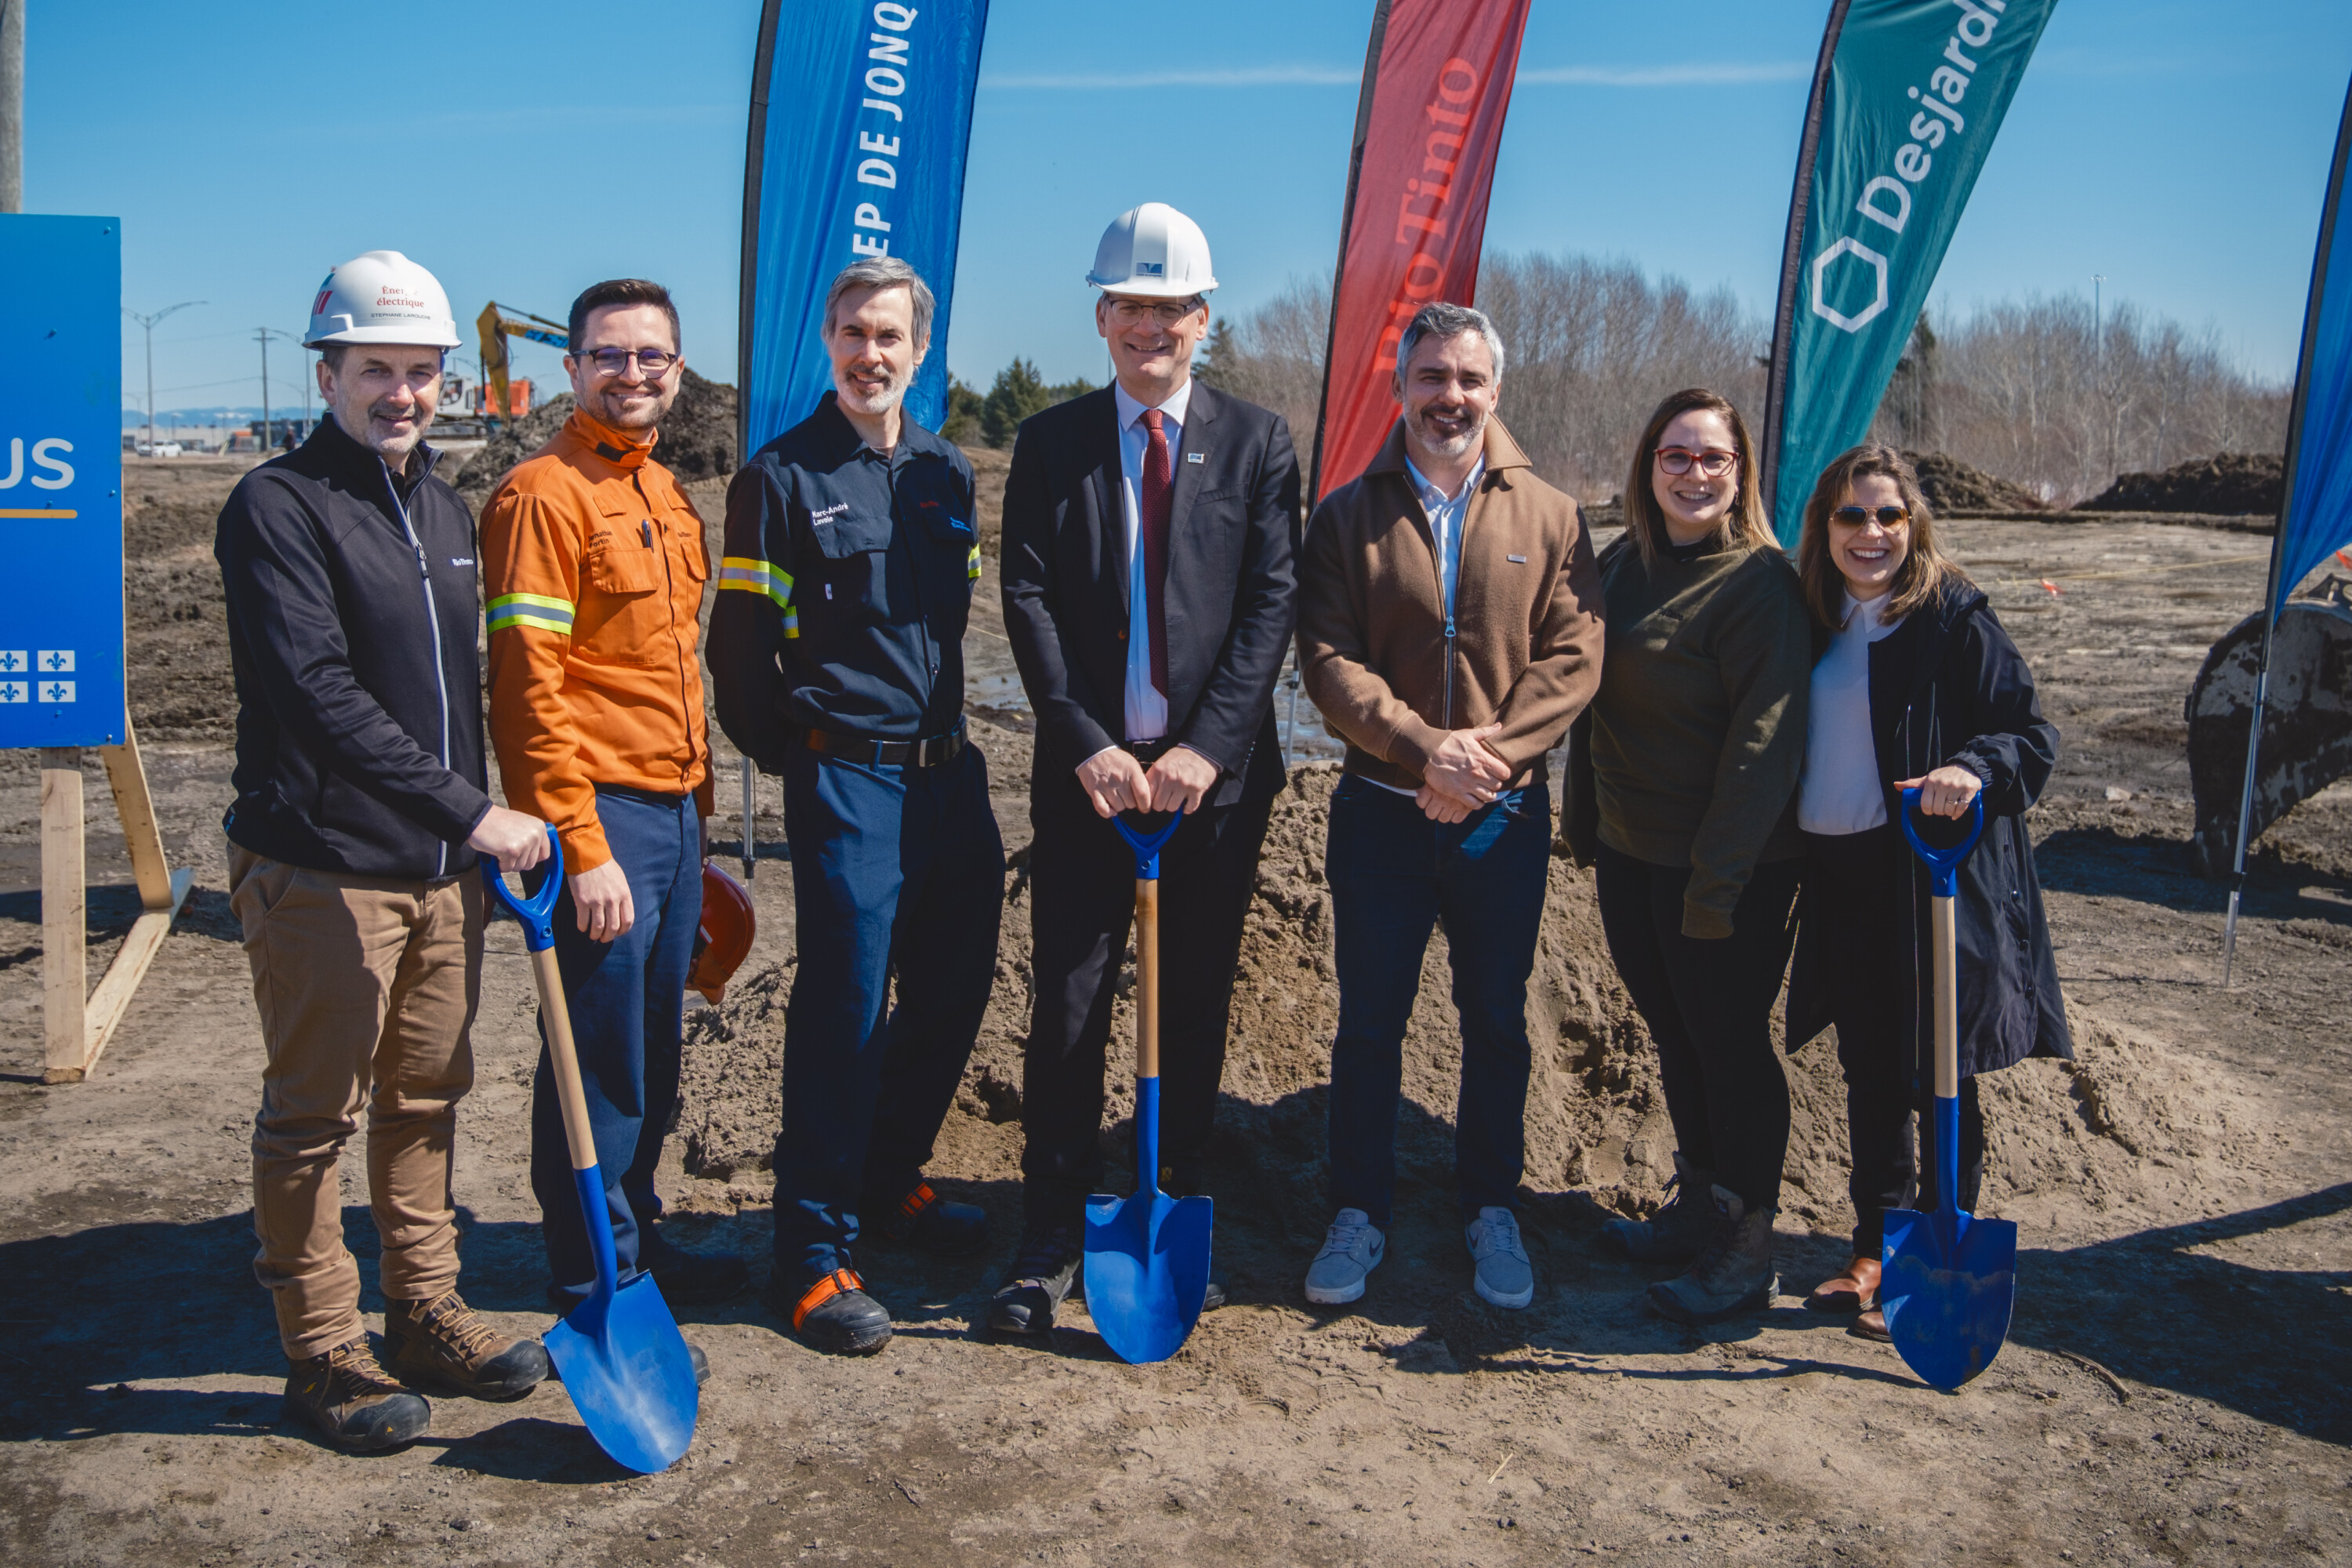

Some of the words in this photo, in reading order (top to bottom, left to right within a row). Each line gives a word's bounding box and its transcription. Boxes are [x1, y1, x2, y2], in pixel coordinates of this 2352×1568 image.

[862, 2, 919, 122] JONQ
[857, 131, 900, 189] DE
[1396, 57, 1478, 245] Tinto
[376, 297, 424, 308] électrique
